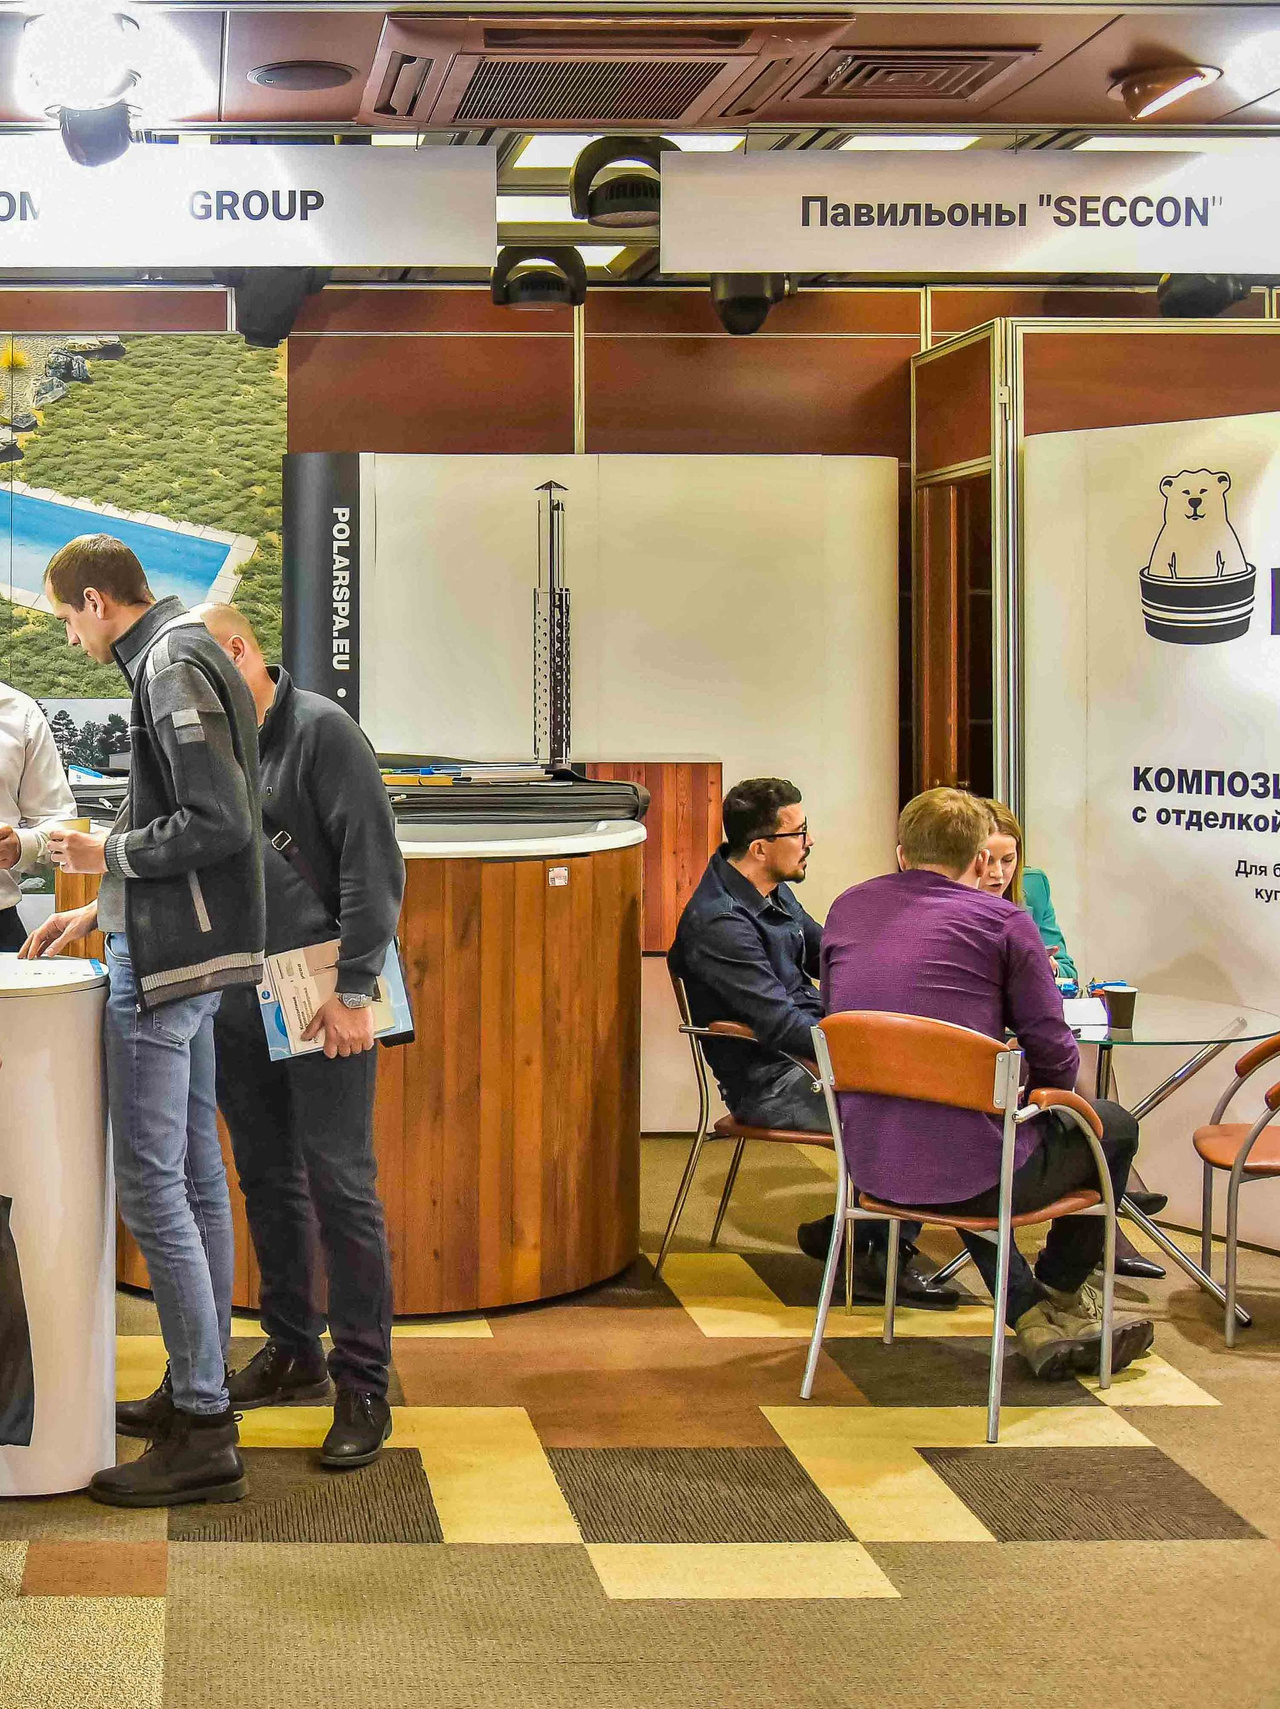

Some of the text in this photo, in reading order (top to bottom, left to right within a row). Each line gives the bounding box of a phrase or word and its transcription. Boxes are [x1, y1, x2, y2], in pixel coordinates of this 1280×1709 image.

[188, 189, 325, 221] GROUP
[800, 193, 1223, 228] Павильоны "SECCON"
[332, 506, 351, 671] POLARSPA.EU
[1132, 806, 1148, 824] с
[1235, 859, 1268, 878] Для
